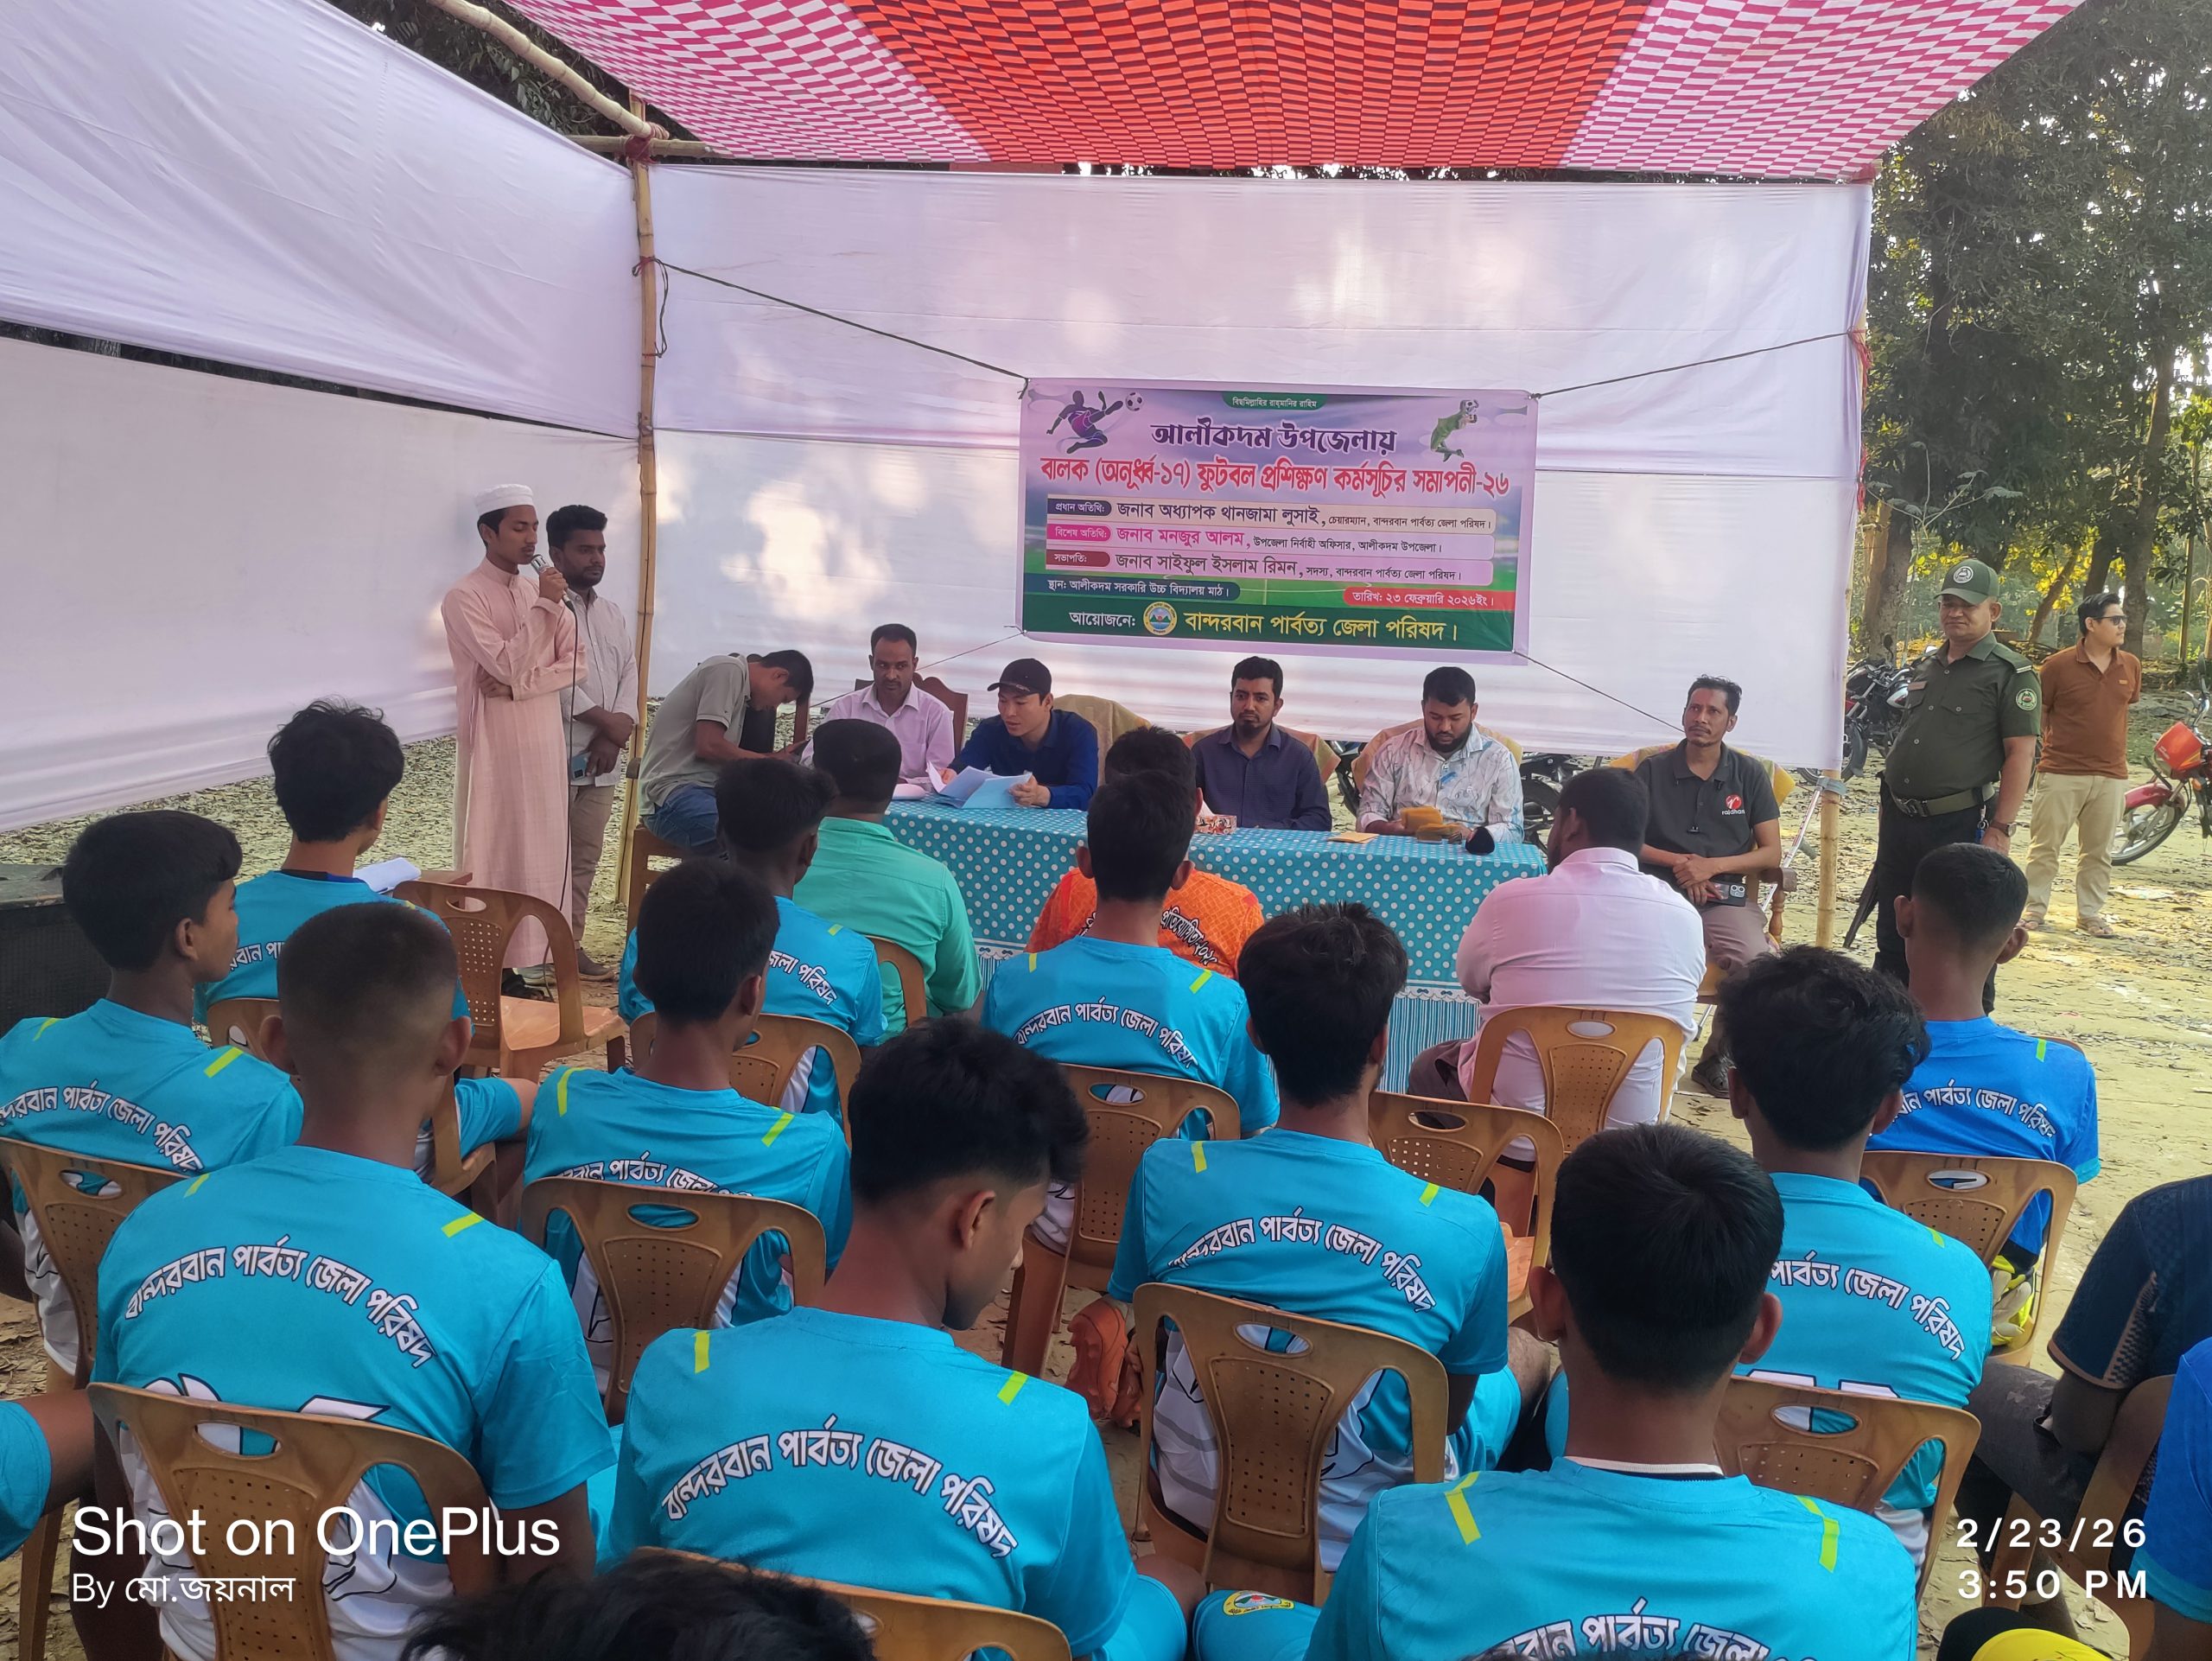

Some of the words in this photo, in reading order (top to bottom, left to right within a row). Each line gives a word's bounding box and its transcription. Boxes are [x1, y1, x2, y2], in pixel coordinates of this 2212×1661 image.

[1150, 417, 1273, 448] আলীকদম
[1277, 422, 1397, 455] উপজেলায়
[1040, 457, 1090, 481] বালক
[1197, 455, 1255, 492] ফুটবল
[1261, 457, 1327, 492] প্রশিক্ষণ
[1334, 461, 1407, 499] কর্মসূচির
[1413, 461, 1509, 499] সমাপনী-২৬
[1055, 503, 1075, 512] প্রধান
[1077, 502, 1105, 513] অতিথি:
[1117, 502, 1154, 519] জনাব
[1160, 504, 1217, 520] অধ্যাপক
[1221, 506, 1277, 523] থানজামা
[1373, 517, 1408, 527] বান্দরবান
[1410, 516, 1435, 528] পার্বত্য
[1438, 519, 1457, 528] জেলা
[1055, 527, 1077, 538] বিশেষ
[1080, 528, 1108, 539] অতিথি:
[1116, 527, 1154, 543] জনাব
[1158, 529, 1201, 547] মনজুর
[1253, 536, 1287, 548] উপজেলা
[1291, 537, 1316, 549] নির্বাহী
[1358, 540, 1398, 551] আলীকদম
[1054, 552, 1087, 563] সভাপতি:
[1116, 553, 1152, 570] জনাব
[1157, 551, 1206, 576] সাইফুল
[1211, 553, 1258, 574] ইসলাম
[1336, 567, 1372, 578] বান্দরবান
[1376, 566, 1402, 579] পার্বত্য
[1404, 570, 1425, 579] জেলা
[1069, 578, 1111, 592] আলীকদম
[1114, 580, 1147, 594] সরকারি
[1149, 581, 1166, 594] উচ্চ
[1169, 583, 1205, 595] বিদ্যালয়
[1386, 593, 1401, 602] ২৩
[1404, 593, 1444, 605] ফেব্রুয়ারি
[1068, 611, 1136, 629] আয়োজনে:
[1183, 612, 1264, 634] বান্দরবান
[1269, 610, 1327, 637] পার্বত্য
[1332, 619, 1379, 639] জেলা
[797, 964, 838, 1006] পরিষদ
[1013, 1004, 1072, 1046] বান্দরবান
[1075, 996, 1120, 1024] পার্বত্য
[1120, 1008, 1160, 1038] জেলা
[1159, 1027, 1199, 1069] পরিষদ
[1923, 1079, 1973, 1106] পার্বত্য
[1975, 1088, 2018, 1116] জেলা
[62, 1079, 113, 1115] পার্বত্য
[107, 1097, 156, 1136] জেলা
[153, 1121, 205, 1173] পরিষদ
[608, 1150, 668, 1183] পার্বত্য
[1259, 1206, 1324, 1245] পার্বত্য
[1324, 1223, 1383, 1265] জেলা
[1381, 1251, 1436, 1313] পরিষদ
[124, 1246, 226, 1320] বান্দরবান
[232, 1234, 309, 1282] পার্বত্য
[305, 1255, 373, 1306] জেলা
[365, 1289, 436, 1369] পরিষদ
[1770, 1250, 1840, 1289] পার্বত্য
[1844, 1268, 1910, 1310] জেলা
[1910, 1295, 1966, 1361] পরিষদ
[661, 1434, 772, 1521] বান্দরবান
[777, 1413, 864, 1469] পার্বত্য
[865, 1437, 944, 1496] জেলা
[940, 1473, 1019, 1558] পরিষদ
[1581, 1595, 1681, 1652] পার্বত্য
